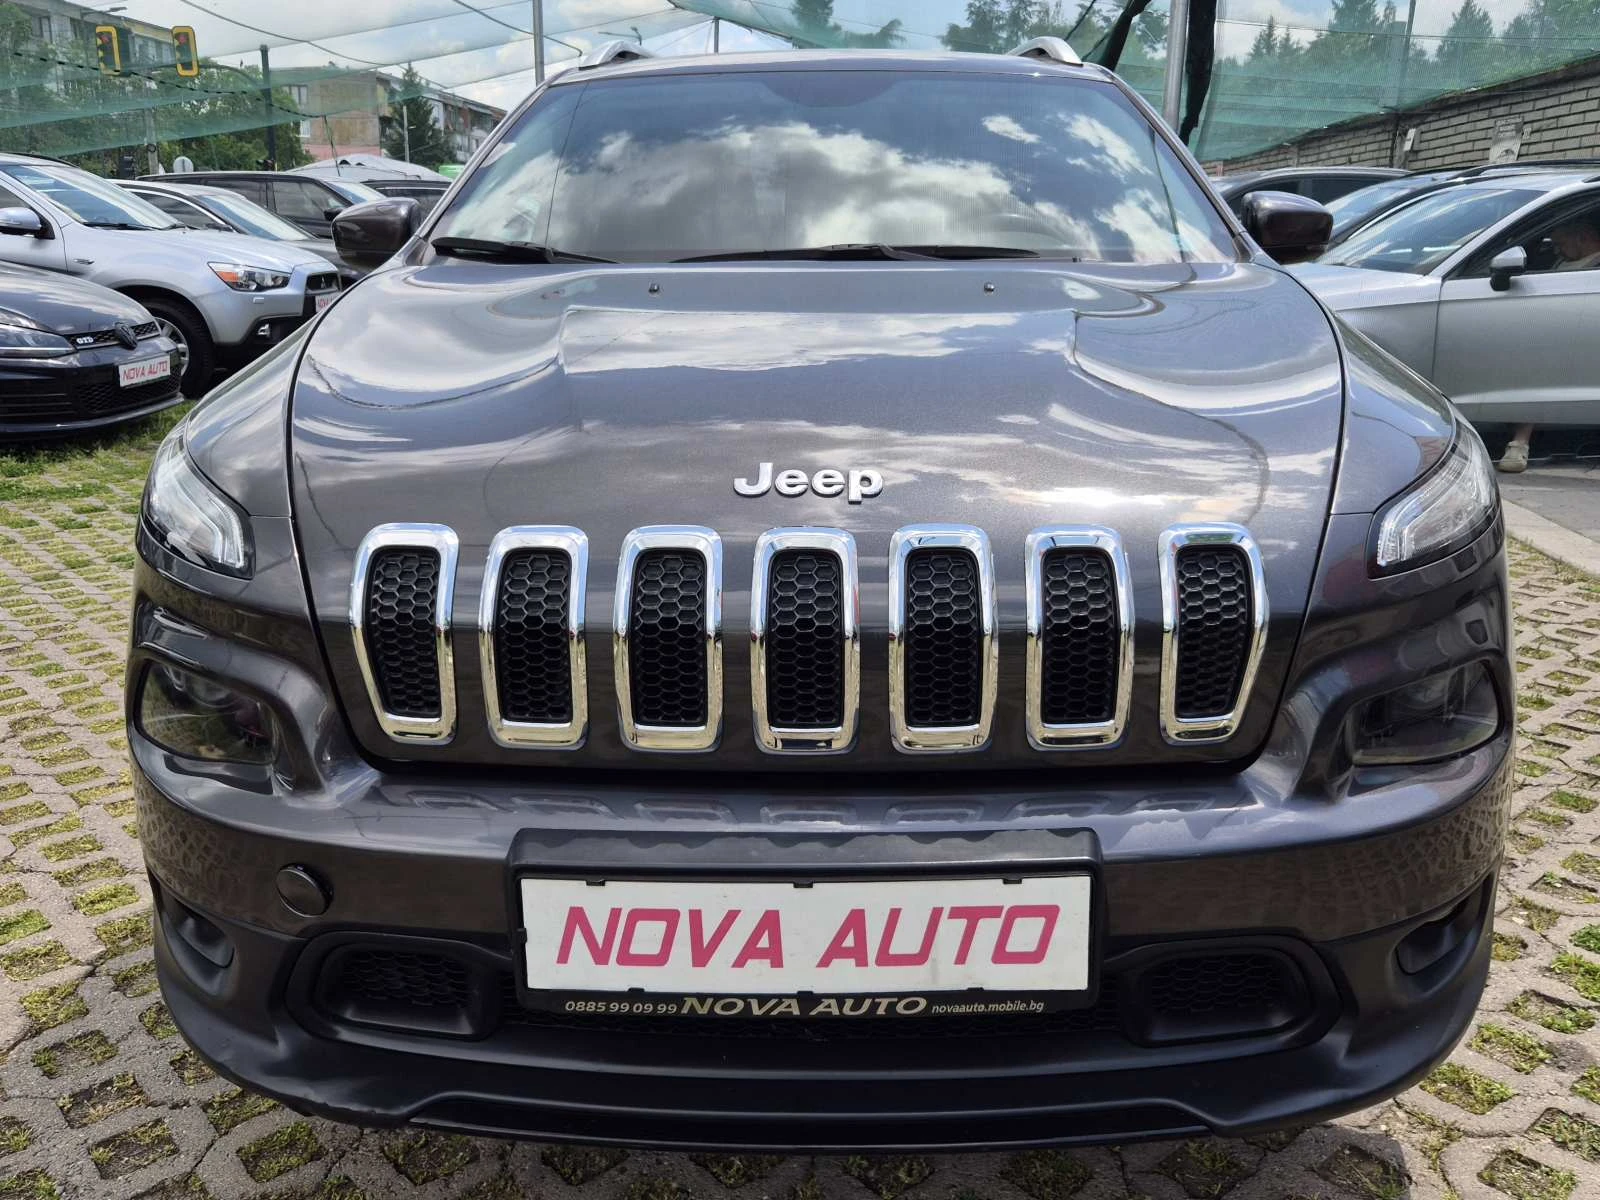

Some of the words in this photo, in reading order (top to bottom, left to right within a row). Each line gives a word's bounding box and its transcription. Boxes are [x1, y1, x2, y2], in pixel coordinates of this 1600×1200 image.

[122, 366, 145, 382] NOVA
[147, 360, 168, 375] AUTO
[733, 462, 883, 505] Jeep
[556, 906, 784, 968] NOVA
[816, 905, 1060, 968] AUTO
[565, 1001, 606, 1012] 0885
[609, 1002, 630, 1013] 99
[632, 1002, 653, 1014] 09
[656, 1003, 678, 1014] 99
[680, 997, 801, 1016] NOVA
[809, 996, 927, 1016] AUTO
[931, 1000, 1045, 1015] novaauto.mobile.bg
